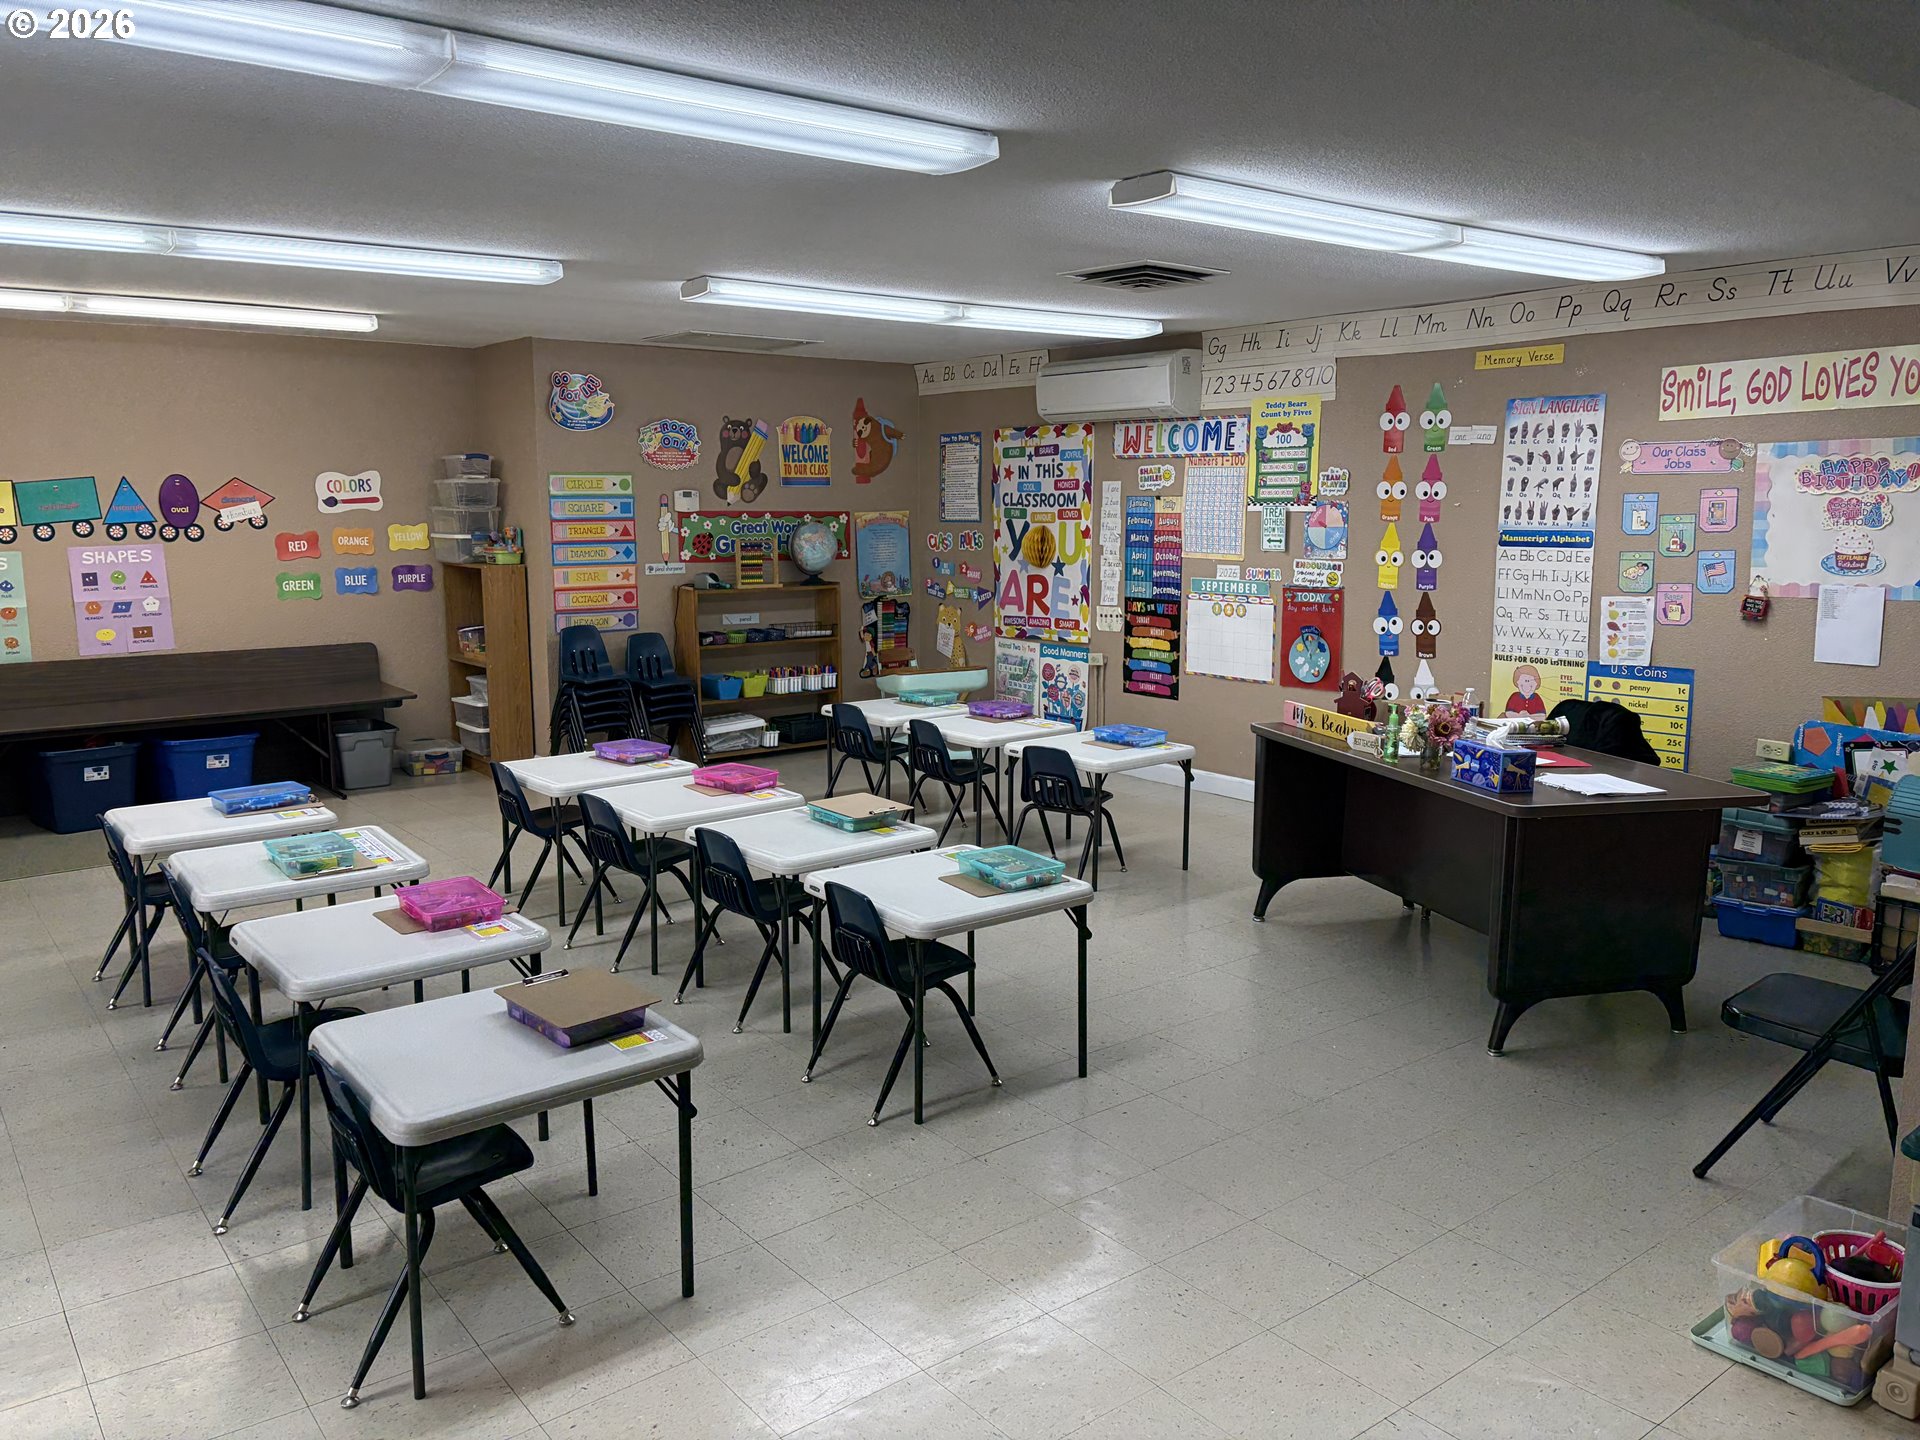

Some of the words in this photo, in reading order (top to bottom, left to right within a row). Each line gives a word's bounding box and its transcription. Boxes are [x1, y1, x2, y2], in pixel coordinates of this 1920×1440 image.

[1208, 337, 1227, 362] Gg
[1240, 332, 1261, 352] Hh
[1276, 329, 1290, 348] Ii
[1306, 324, 1322, 353] Jj
[1338, 320, 1361, 341] Kk
[1379, 316, 1399, 338] Ll
[1414, 313, 1447, 335] Mm
[1466, 306, 1495, 329] Nn
[1510, 301, 1535, 324] Oo
[1555, 295, 1582, 327] Pp
[1603, 289, 1632, 321] Qq
[1655, 283, 1687, 308] Rr
[1707, 277, 1737, 301] Ss
[1768, 268, 1794, 295] Tt
[1814, 263, 1853, 290] Uu
[1886, 256, 1919, 284] Vv
[1484, 354, 1522, 367] Memory
[1528, 351, 1554, 362] Verse
[922, 369, 935, 383] Aa
[943, 366, 955, 381] Bb
[963, 363, 975, 379] Cc
[983, 361, 998, 377] Dd
[1009, 359, 1020, 375] Ee
[1029, 356, 1043, 373] Ff
[1746, 366, 1792, 405] GOD
[1802, 351, 1879, 402] LOVES
[560, 387, 580, 401] for
[1265, 402, 1286, 410] Teddy
[1287, 400, 1307, 408] Bears
[1512, 400, 1538, 415] SIGN
[1539, 398, 1600, 414] LANGUAGE
[1261, 410, 1281, 418] Count
[1293, 409, 1312, 417] Fives
[661, 421, 695, 439] Rock
[661, 435, 688, 450] On!
[1122, 421, 1237, 454] WELCOME
[1275, 434, 1292, 444] 100
[781, 444, 829, 463] WELCOME
[1039, 447, 1055, 455] BRAVE
[1652, 446, 1672, 458] Our
[1675, 445, 1706, 457] Class
[1188, 457, 1218, 466] Numbers
[1664, 458, 1691, 469] Jobs
[1820, 459, 1889, 475] HAPPY
[783, 463, 792, 475] TO
[793, 463, 808, 475] OUR
[809, 463, 828, 475] CLASS
[1018, 465, 1029, 480] IN
[326, 478, 372, 493] COLORS
[566, 479, 603, 490] CIRCLE
[1057, 481, 1076, 489] HONEST
[1002, 492, 1077, 508] CLASSROOM
[1129, 500, 1152, 510] January
[170, 506, 190, 514] oval
[568, 503, 604, 513] SQUARE
[1062, 510, 1078, 518] LOVED
[731, 519, 769, 534] Great
[1127, 517, 1153, 527] February
[1158, 517, 1179, 526] August
[568, 526, 606, 535] TRIANGLE
[338, 536, 369, 546] ORANGE
[394, 531, 424, 542] YELLOW
[928, 533, 953, 552] CLASS
[959, 530, 984, 550] RULES
[1130, 533, 1149, 542] March
[1153, 534, 1182, 545] September
[1502, 535, 1549, 543] Manuscript
[1550, 535, 1590, 543] Alphabet
[288, 540, 308, 552] RED
[81, 549, 153, 565] SHAPES
[570, 549, 607, 558] DIAMOND
[1131, 551, 1147, 560] April
[1155, 552, 1180, 561] October
[1498, 549, 1516, 561] Aa
[1520, 550, 1534, 561] Bb
[1536, 550, 1553, 562] Cc
[1556, 550, 1572, 563] Dd
[1575, 551, 1590, 563] Ee
[576, 572, 600, 582] STAR
[1132, 567, 1144, 577] May
[1153, 569, 1181, 578] November
[1218, 567, 1238, 578] 2026
[1246, 568, 1281, 580] SUMMER
[344, 575, 367, 586] BLUE
[398, 573, 426, 583] PURPLE
[282, 580, 314, 592] GREEN
[1131, 585, 1146, 593] June
[1152, 586, 1181, 596] December
[1201, 580, 1258, 594] SEPTEMBER
[571, 594, 608, 604] OCTAGON
[1000, 569, 1071, 619] ARE
[1298, 592, 1326, 602] TODAY
[1127, 600, 1146, 613] DAYS
[1156, 603, 1178, 615] WEEK
[1287, 604, 1297, 612] day
[1302, 604, 1318, 612] month
[573, 616, 609, 627] HEXAGON
[1059, 620, 1075, 628] SMART
[1042, 646, 1059, 656] Good
[1060, 648, 1087, 660] Manners
[1494, 654, 1513, 662] RULES
[1529, 656, 1549, 665] GOOD
[1611, 664, 1630, 675] U.S.
[1634, 666, 1668, 678] Coins
[1629, 684, 1651, 693] penny
[1678, 687, 1686, 695] 1¢
[1628, 701, 1648, 709] nickel
[1292, 705, 1317, 729] Mrs.
[1670, 721, 1683, 730] 10¢
[1666, 738, 1682, 747] 25¢
[1665, 756, 1681, 764] 50¢
